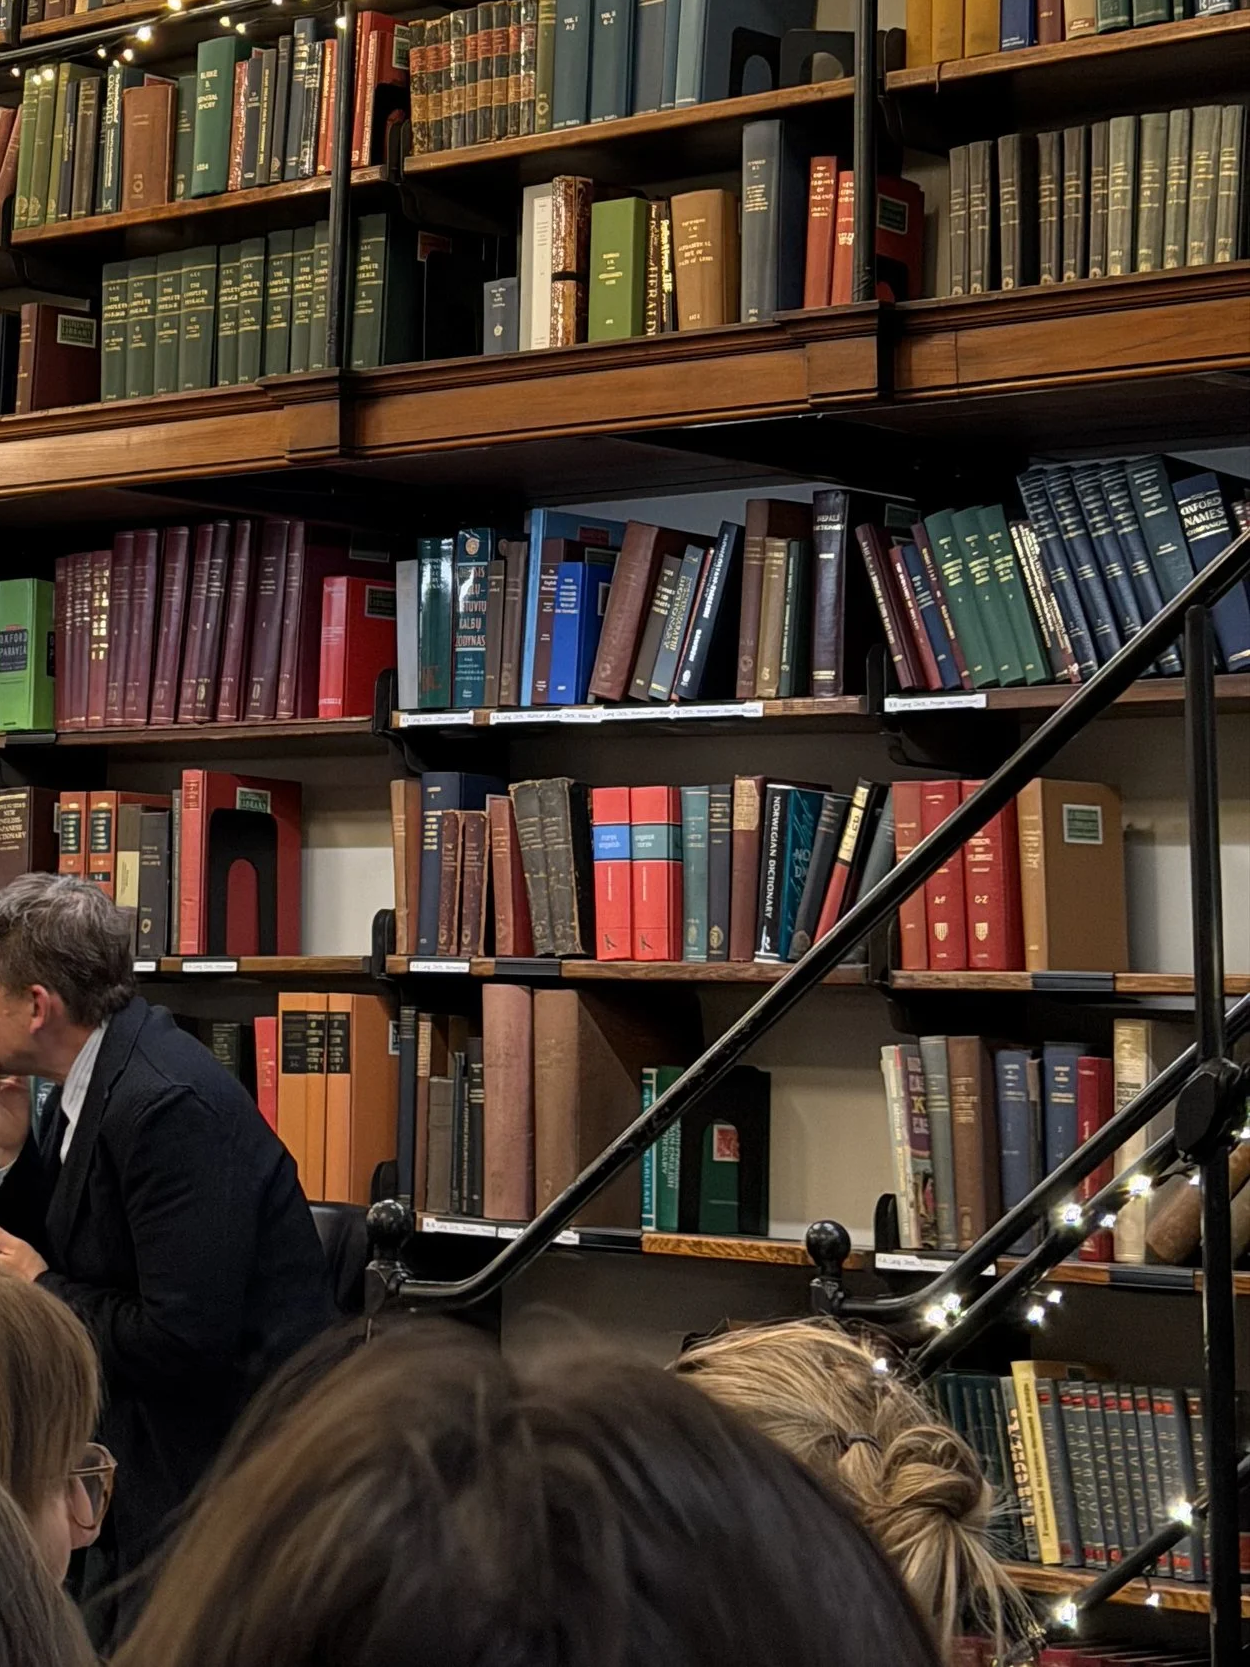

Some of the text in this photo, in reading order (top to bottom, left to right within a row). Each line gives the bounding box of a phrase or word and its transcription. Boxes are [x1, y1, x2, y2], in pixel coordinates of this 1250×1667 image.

[105, 74, 115, 124] OXFORD
[646, 265, 658, 336] HERALD
[1183, 506, 1226, 529] NAMES
[0, 632, 28, 644] OXFORD
[764, 796, 781, 919] NORWEGIAN DICTIONARY
